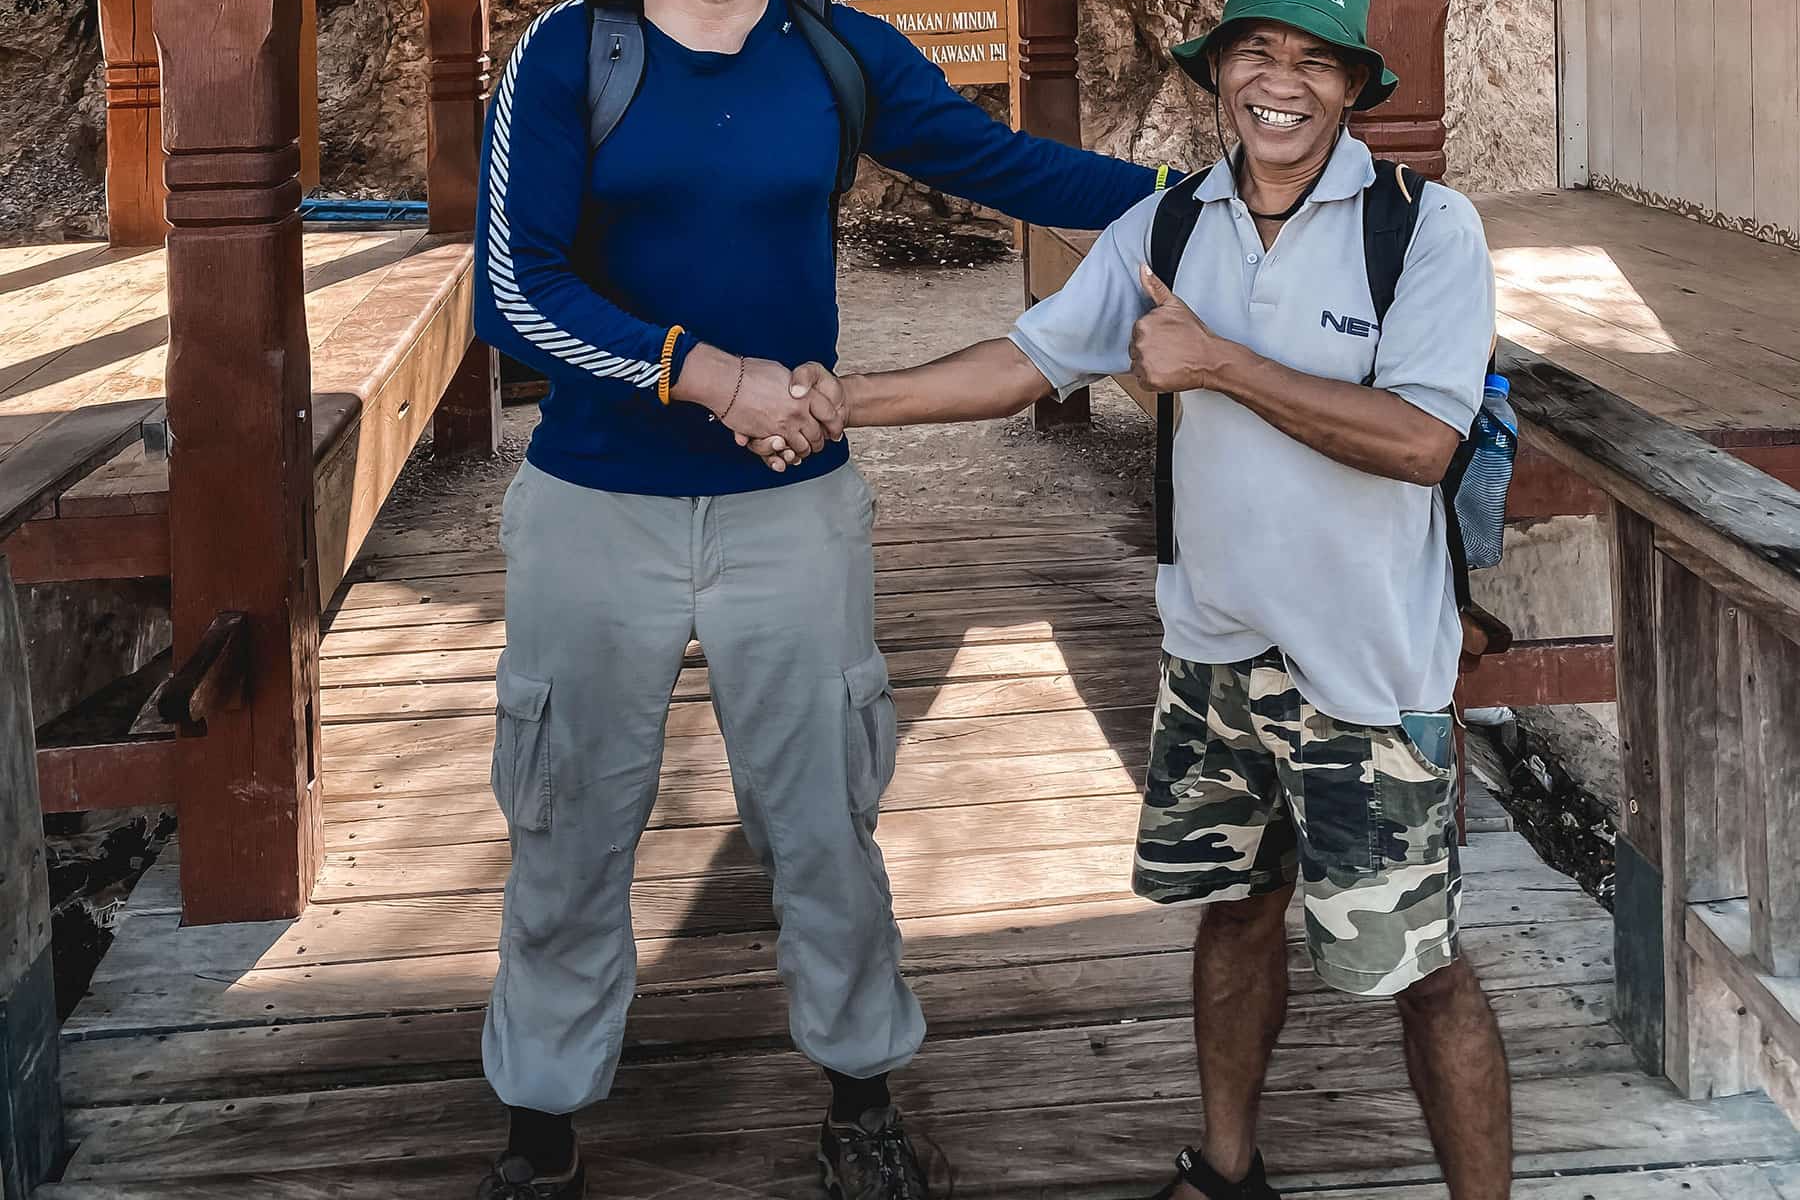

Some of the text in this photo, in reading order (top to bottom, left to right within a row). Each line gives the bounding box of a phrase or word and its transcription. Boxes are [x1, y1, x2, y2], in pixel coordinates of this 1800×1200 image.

[896, 12, 943, 32] MAKAN
[952, 10, 998, 30] MINUM
[931, 43, 986, 64] KAWASAN
[990, 42, 1007, 62] INI
